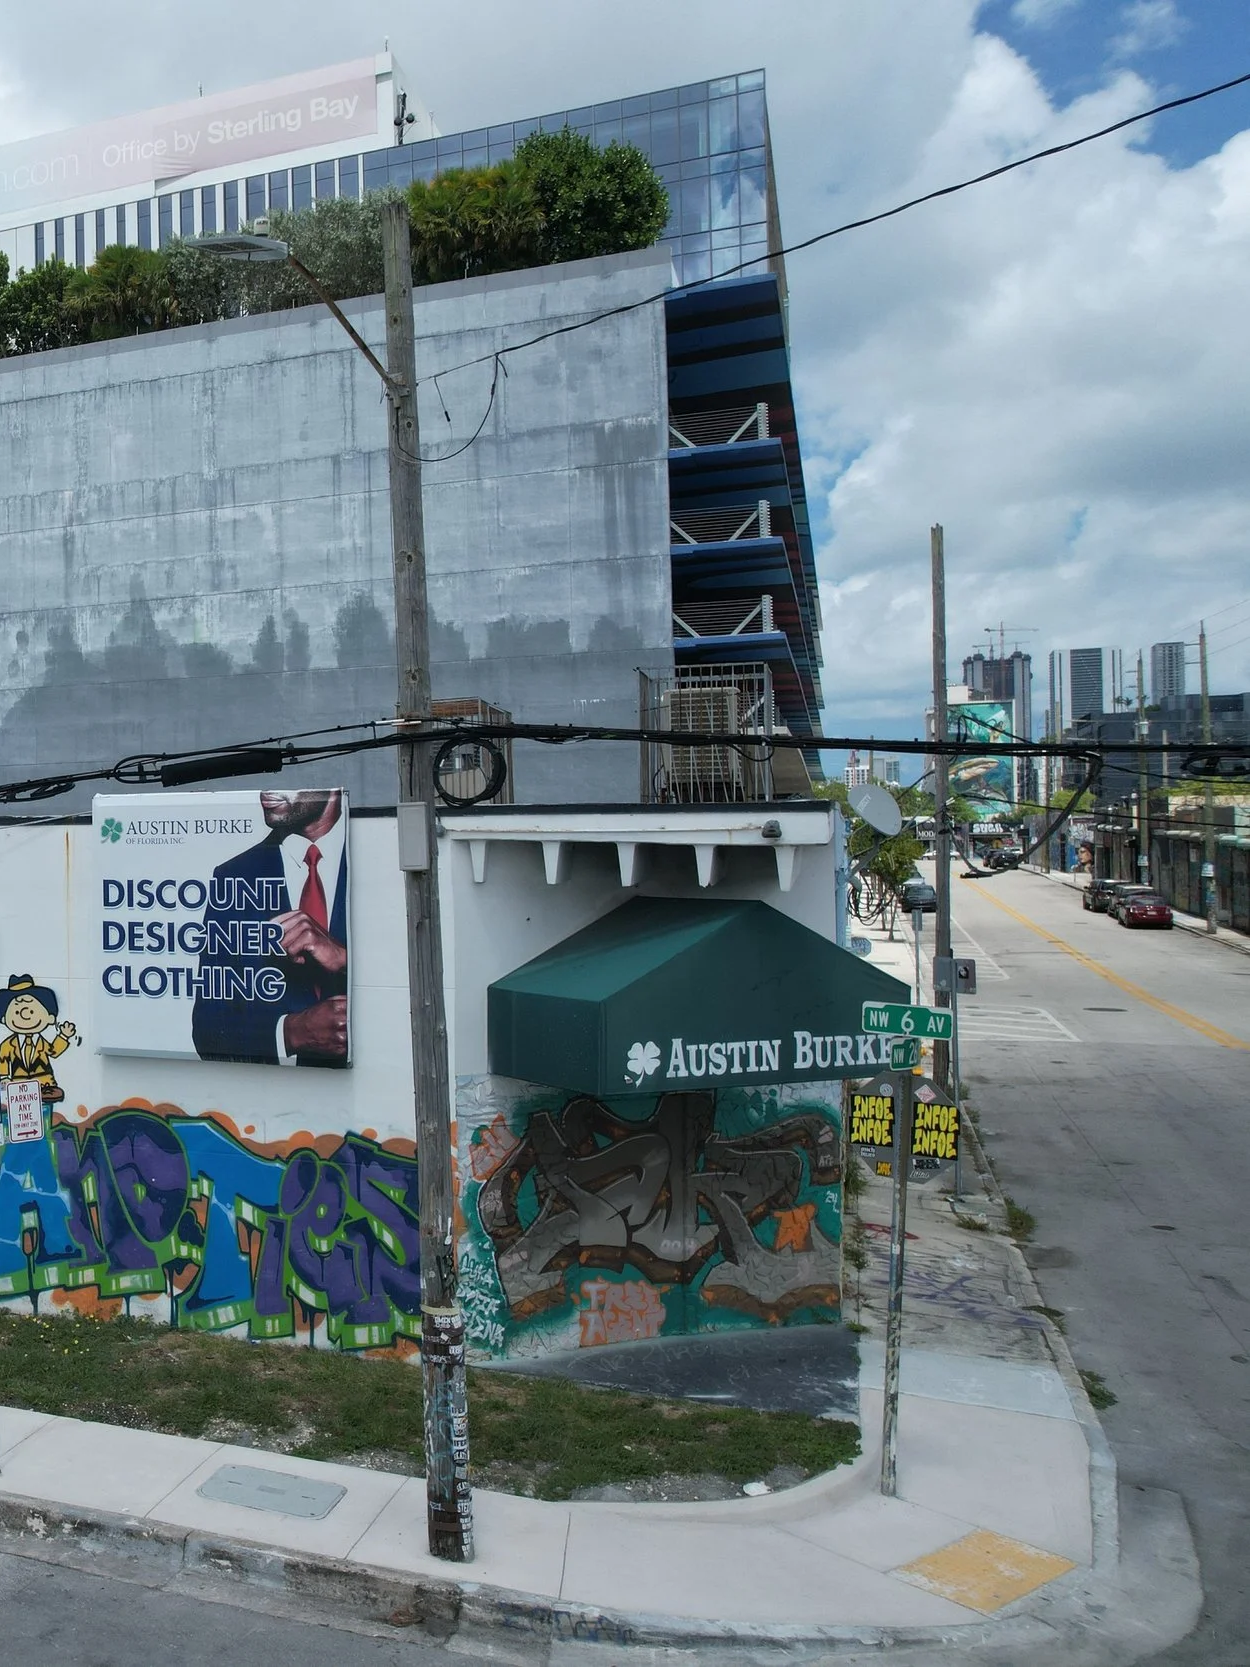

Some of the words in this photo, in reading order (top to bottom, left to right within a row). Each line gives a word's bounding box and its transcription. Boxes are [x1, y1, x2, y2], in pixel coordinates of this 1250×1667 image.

[102, 137, 168, 168] Office
[174, 130, 201, 153] by
[207, 108, 302, 144] Sterling
[309, 93, 359, 121] Bay
[126, 820, 188, 835] AUSTIN
[194, 819, 253, 834] BURKE
[102, 877, 285, 910] DISCOUNT
[102, 921, 286, 956] DESIGNER
[102, 965, 286, 1001] CLOTHING
[870, 1010, 889, 1027] NW
[901, 1010, 914, 1032] 6
[927, 1016, 945, 1033] AV
[666, 1037, 782, 1079] AUSTIN
[793, 1030, 892, 1069] BURKE
[893, 1048, 904, 1064] NW
[19, 1084, 28, 1092] NO
[11, 1093, 38, 1103] PARKING
[19, 1103, 31, 1111] ANY
[19, 1113, 33, 1121] TIME
